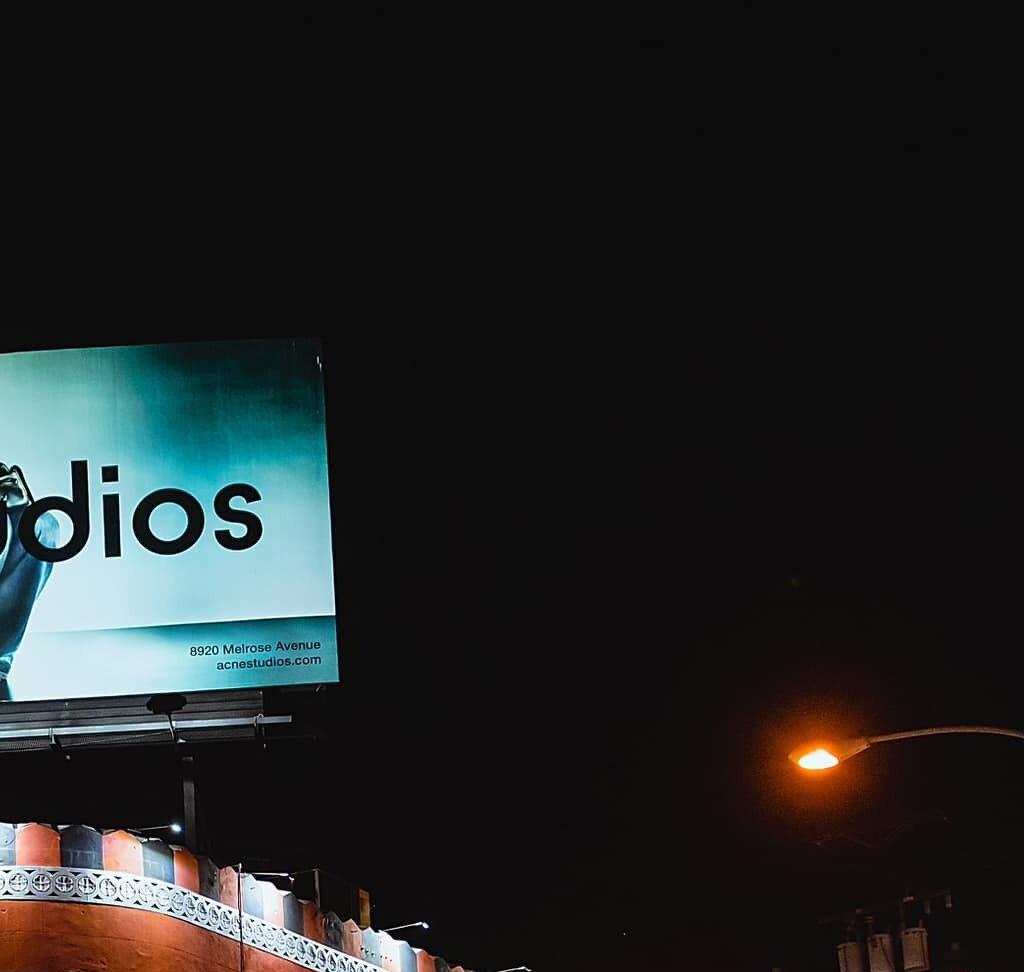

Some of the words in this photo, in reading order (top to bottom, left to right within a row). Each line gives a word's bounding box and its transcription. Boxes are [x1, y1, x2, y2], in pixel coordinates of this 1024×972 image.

[190, 645, 219, 656] 8920
[223, 643, 272, 655] Melrose
[276, 640, 321, 651] Avenue
[216, 655, 322, 670] acnestudios.com
